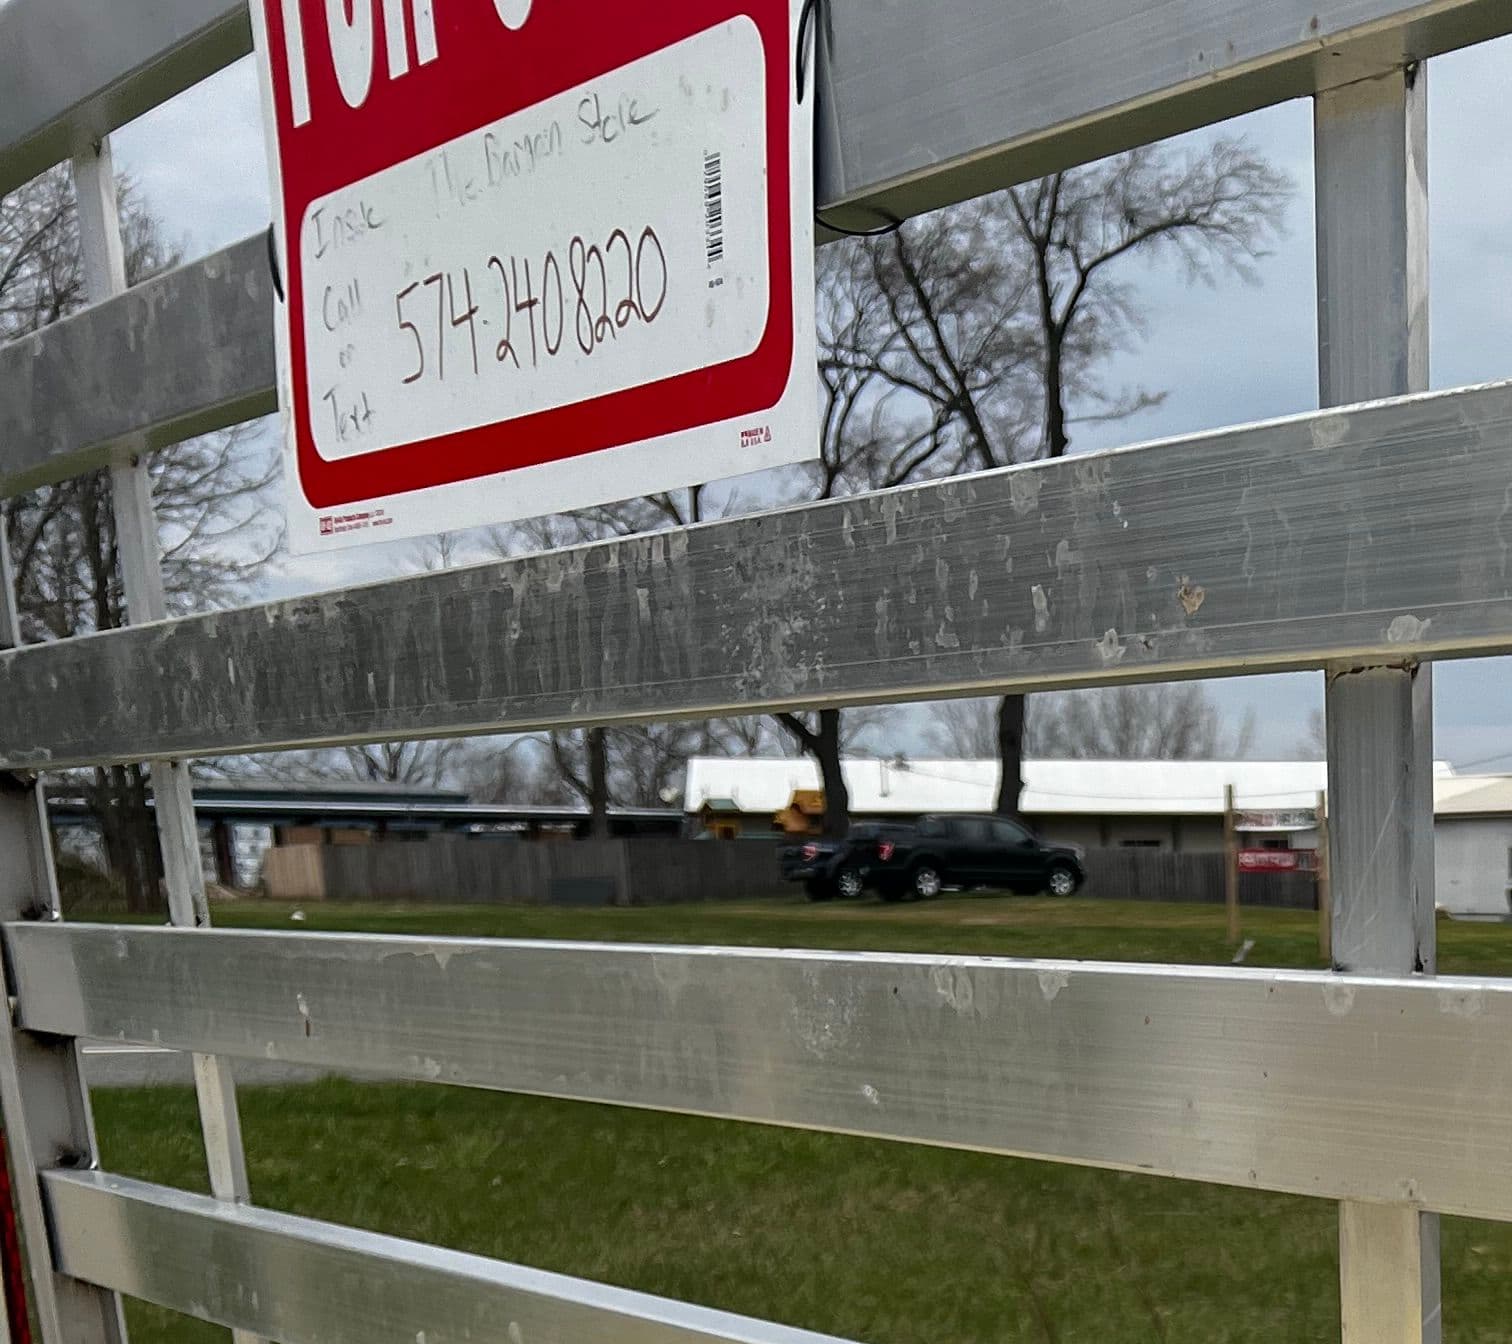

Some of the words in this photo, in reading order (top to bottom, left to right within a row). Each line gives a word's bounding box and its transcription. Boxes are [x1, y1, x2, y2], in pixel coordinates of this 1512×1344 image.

[577, 92, 660, 145] Store
[322, 277, 361, 332] Call
[322, 385, 376, 442] Text
